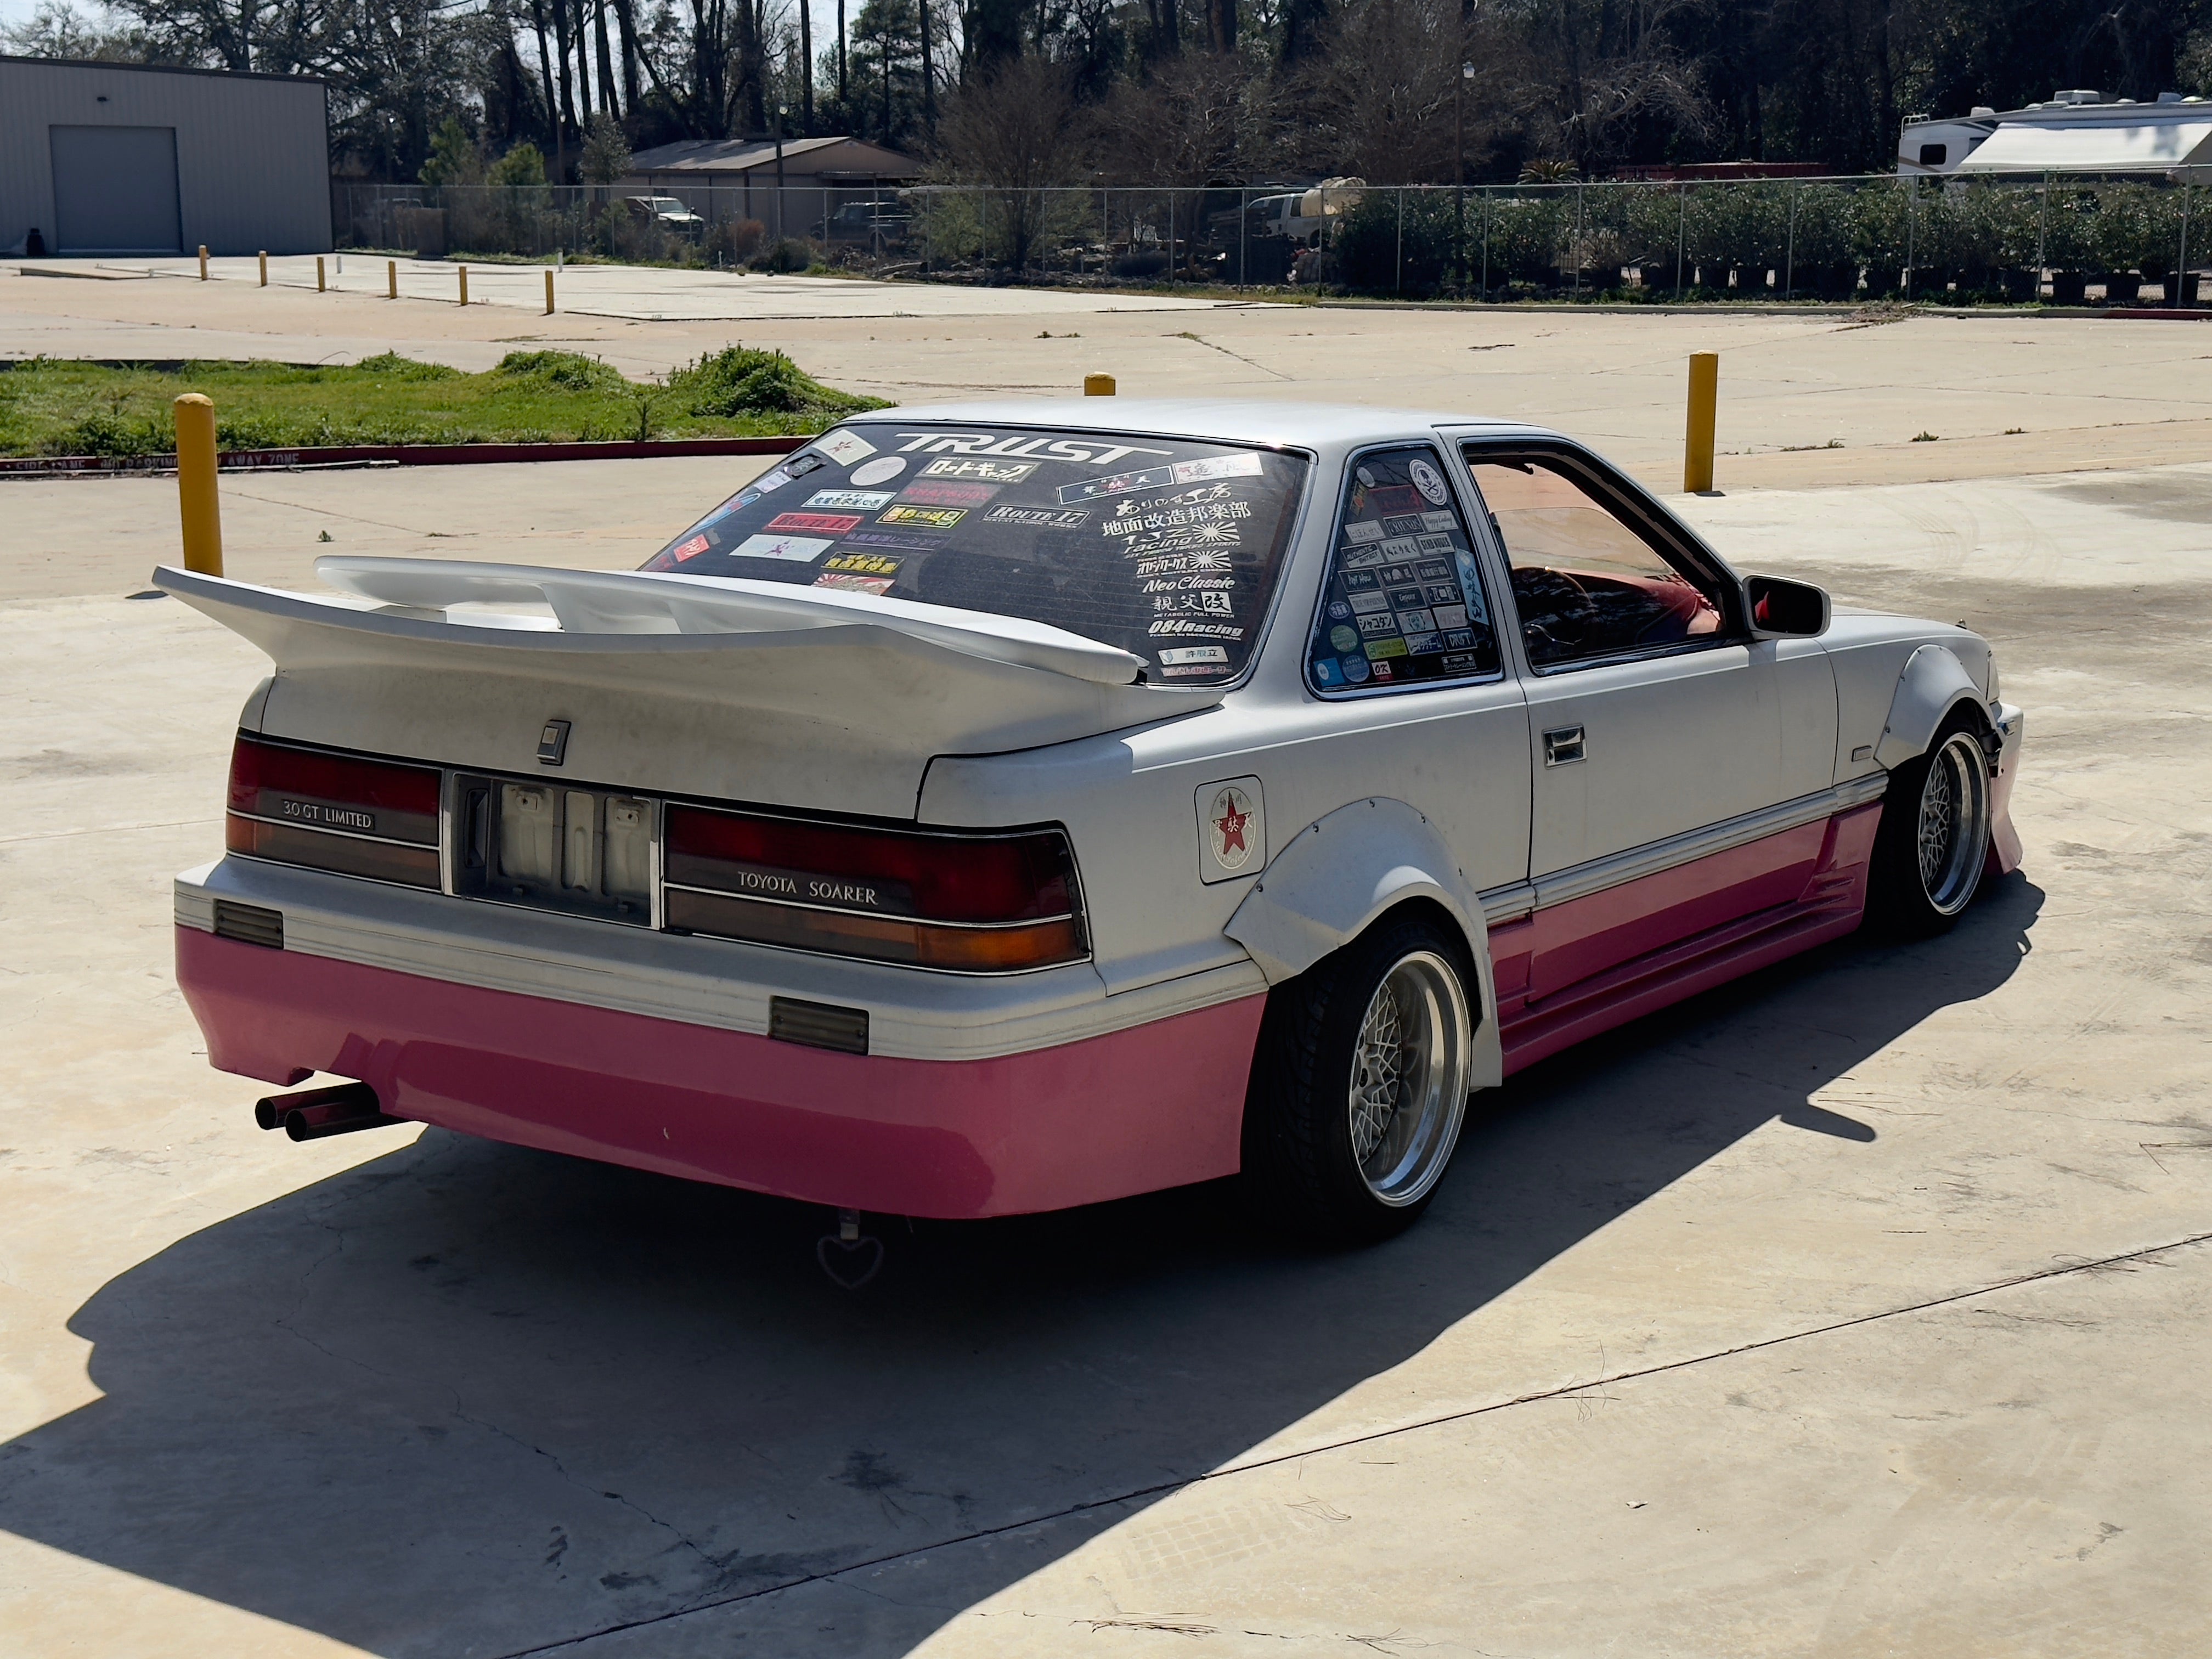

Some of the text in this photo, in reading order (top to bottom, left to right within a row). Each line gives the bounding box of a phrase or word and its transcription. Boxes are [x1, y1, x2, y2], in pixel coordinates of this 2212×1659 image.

[895, 433, 1173, 464] TRUST
[1054, 511, 1086, 523] 17
[1124, 537, 1192, 554] racing
[1359, 616, 1392, 630] シャコタン
[1448, 633, 1471, 647] DRIFT
[303, 804, 319, 819] GT
[325, 807, 372, 828] LIMITED
[737, 871, 879, 905] TOYOTA SOARER
